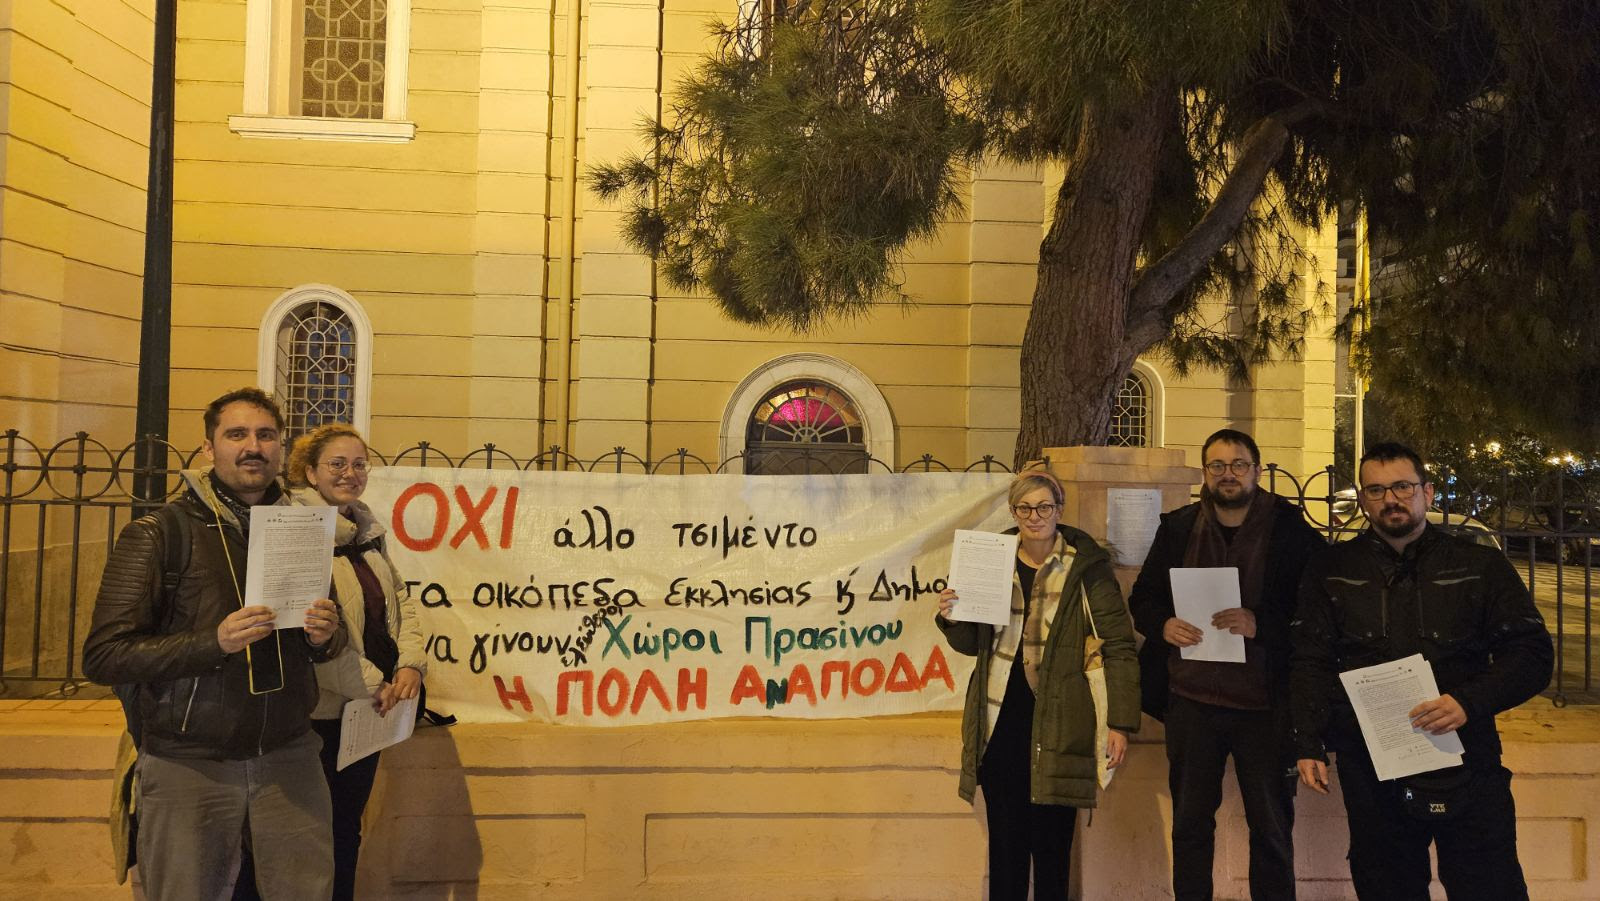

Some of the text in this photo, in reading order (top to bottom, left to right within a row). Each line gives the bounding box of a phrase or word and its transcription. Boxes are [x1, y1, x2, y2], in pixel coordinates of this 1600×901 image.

[392, 482, 818, 559] ΟΧΙ άλλο τσιμέντο
[472, 574, 647, 611] οικόπεδα
[868, 565, 949, 602] Δημο
[469, 623, 572, 674] γίνουν
[745, 616, 903, 666] Πρασίνου
[555, 667, 708, 717] ΠΟΛΗ
[729, 644, 956, 709] ΑΝΑΠΟΔΑ
